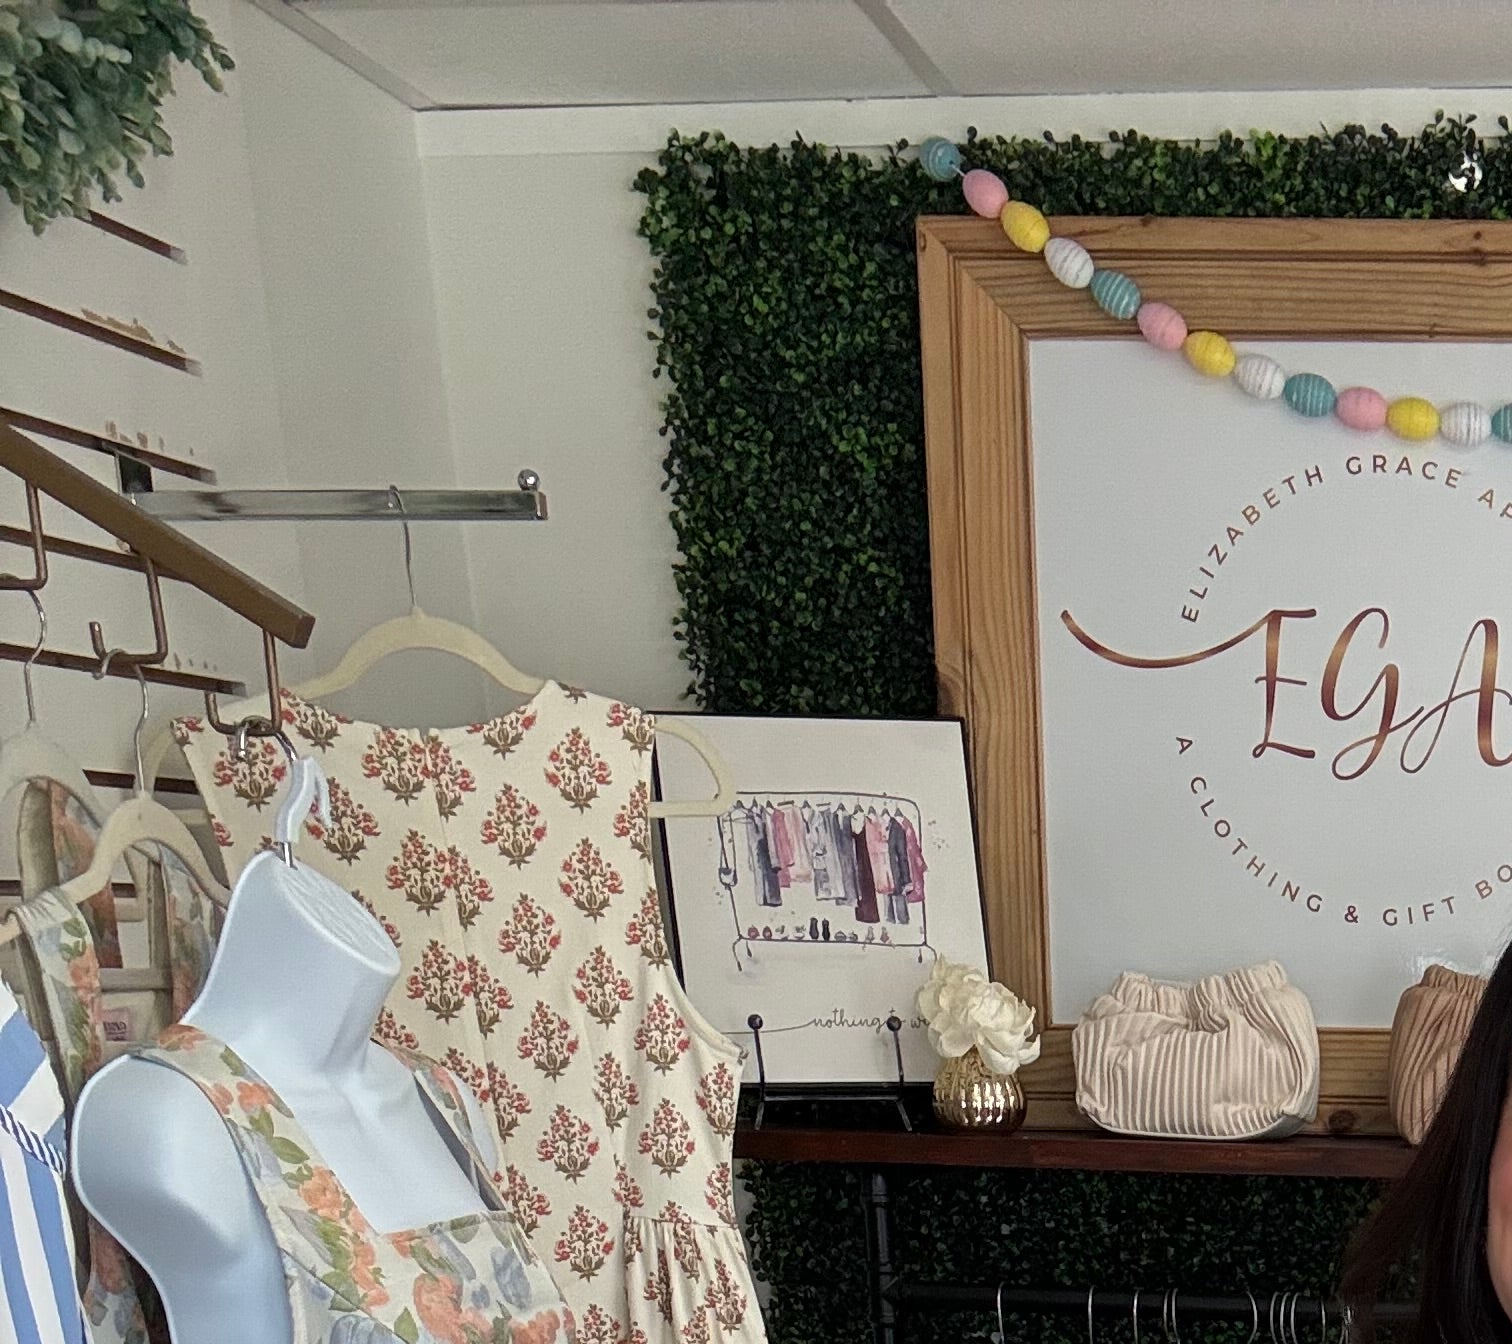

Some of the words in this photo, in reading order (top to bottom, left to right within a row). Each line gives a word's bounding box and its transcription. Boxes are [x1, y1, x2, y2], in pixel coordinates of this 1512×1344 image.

[1180, 464, 1324, 624] ELIZABETH
[1345, 454, 1462, 489] GRACE
[1175, 736, 1194, 756] A
[1190, 776, 1323, 913] CLOTHING
[1343, 904, 1359, 924] &
[1382, 895, 1455, 927] GIFT
[805, 1008, 884, 1033] nothing
